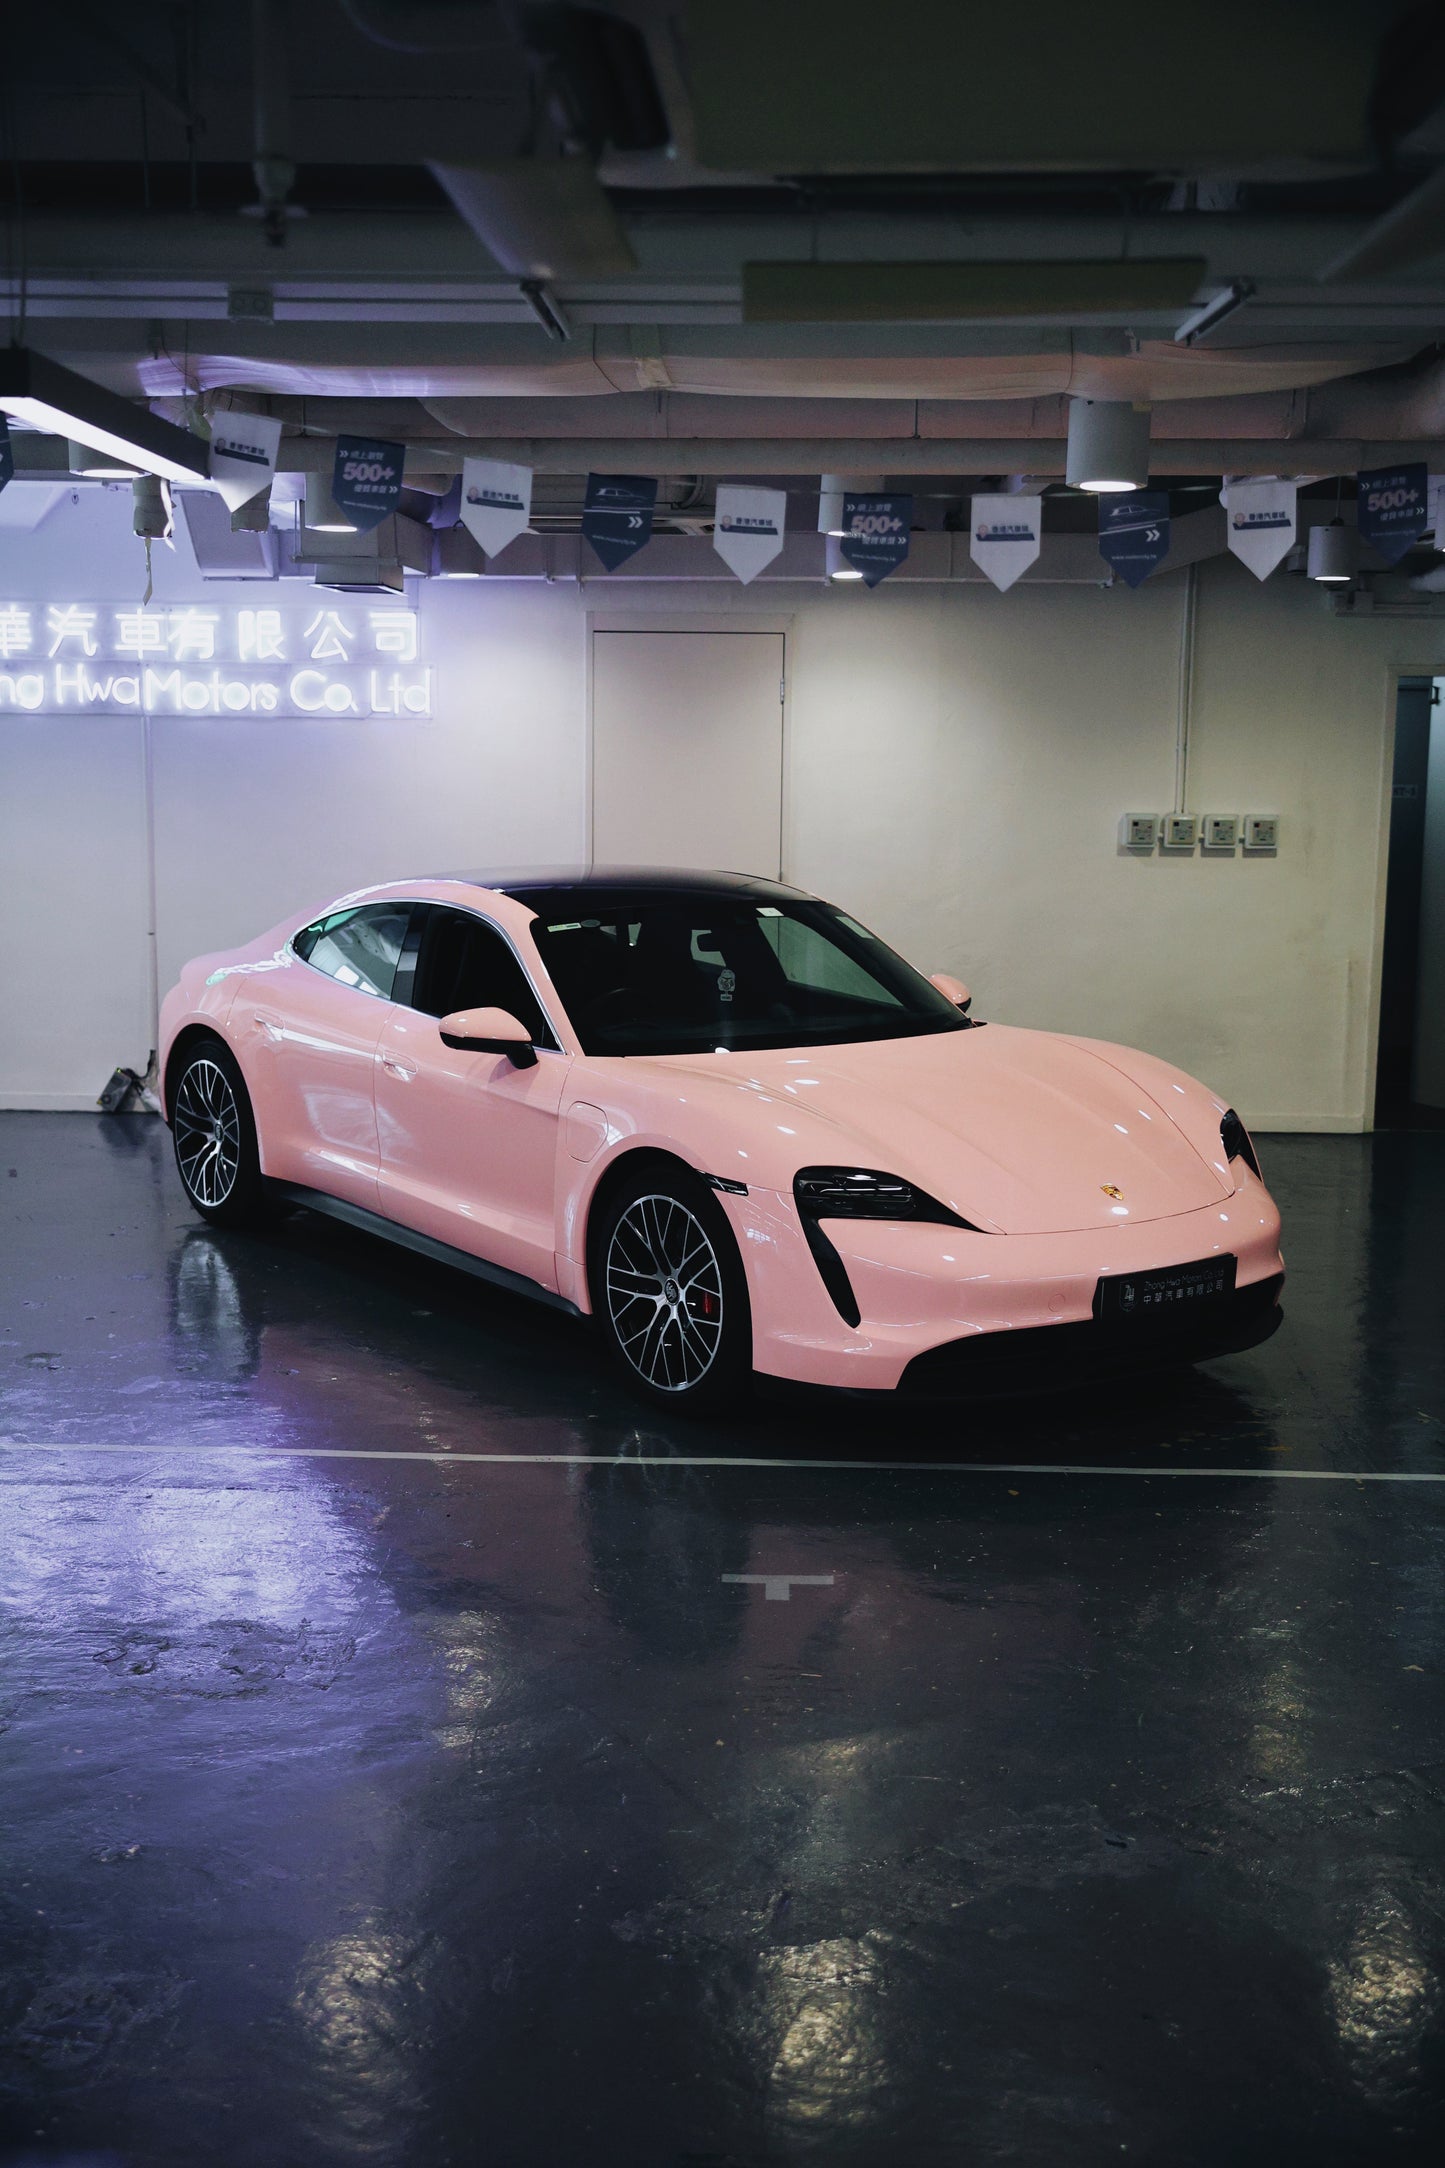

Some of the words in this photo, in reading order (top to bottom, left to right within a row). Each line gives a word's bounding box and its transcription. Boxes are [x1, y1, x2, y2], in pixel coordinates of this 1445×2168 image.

[342, 462, 396, 482] 500+
[1367, 488, 1420, 512] 500+
[851, 514, 903, 535] 500+
[56, 663, 140, 706] Hwa
[145, 669, 279, 712] Motors
[371, 668, 431, 714] Ltd
